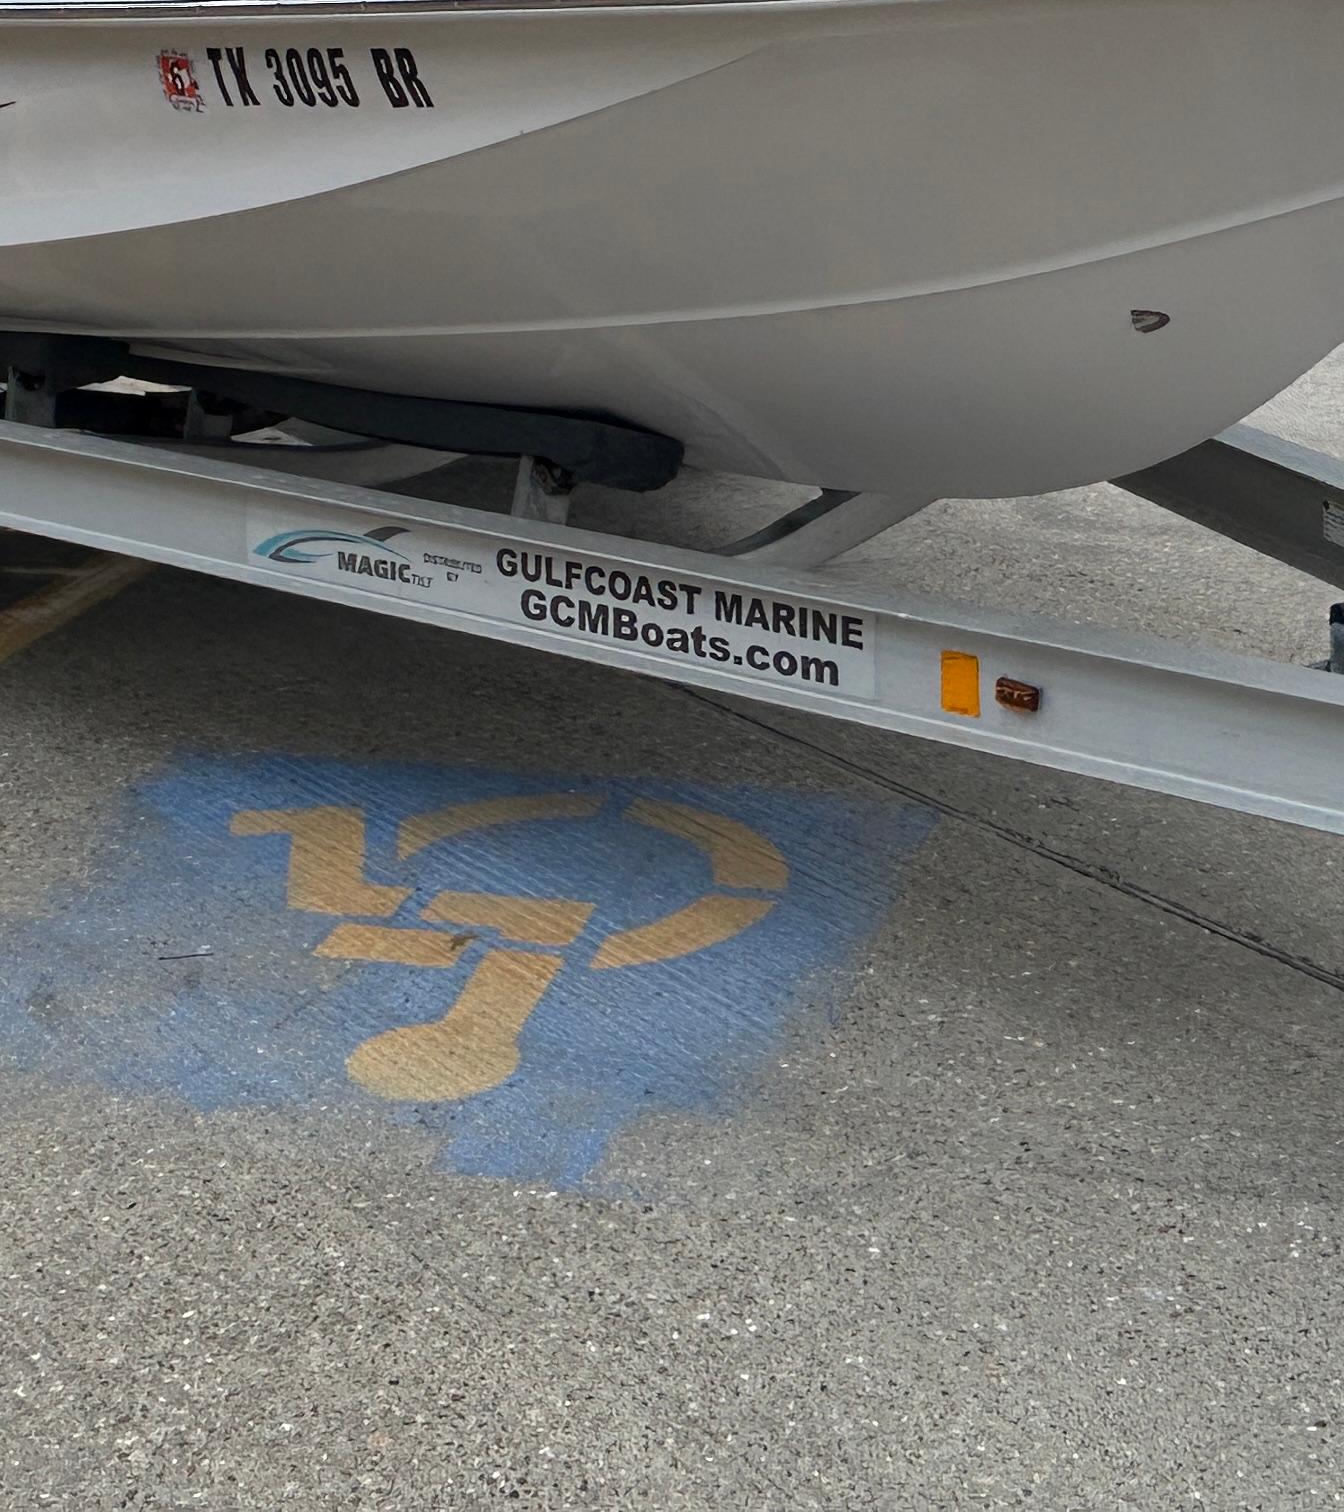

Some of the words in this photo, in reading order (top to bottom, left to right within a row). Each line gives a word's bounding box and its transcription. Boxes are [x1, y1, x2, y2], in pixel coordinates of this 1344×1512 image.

[206, 46, 260, 106] TX
[264, 47, 360, 108] 3095
[370, 47, 434, 108] BR
[337, 551, 412, 584] MAGIC
[496, 548, 703, 615] GULFCOAST
[714, 590, 864, 650] MARINE
[520, 589, 840, 686] GCMBoats.com
